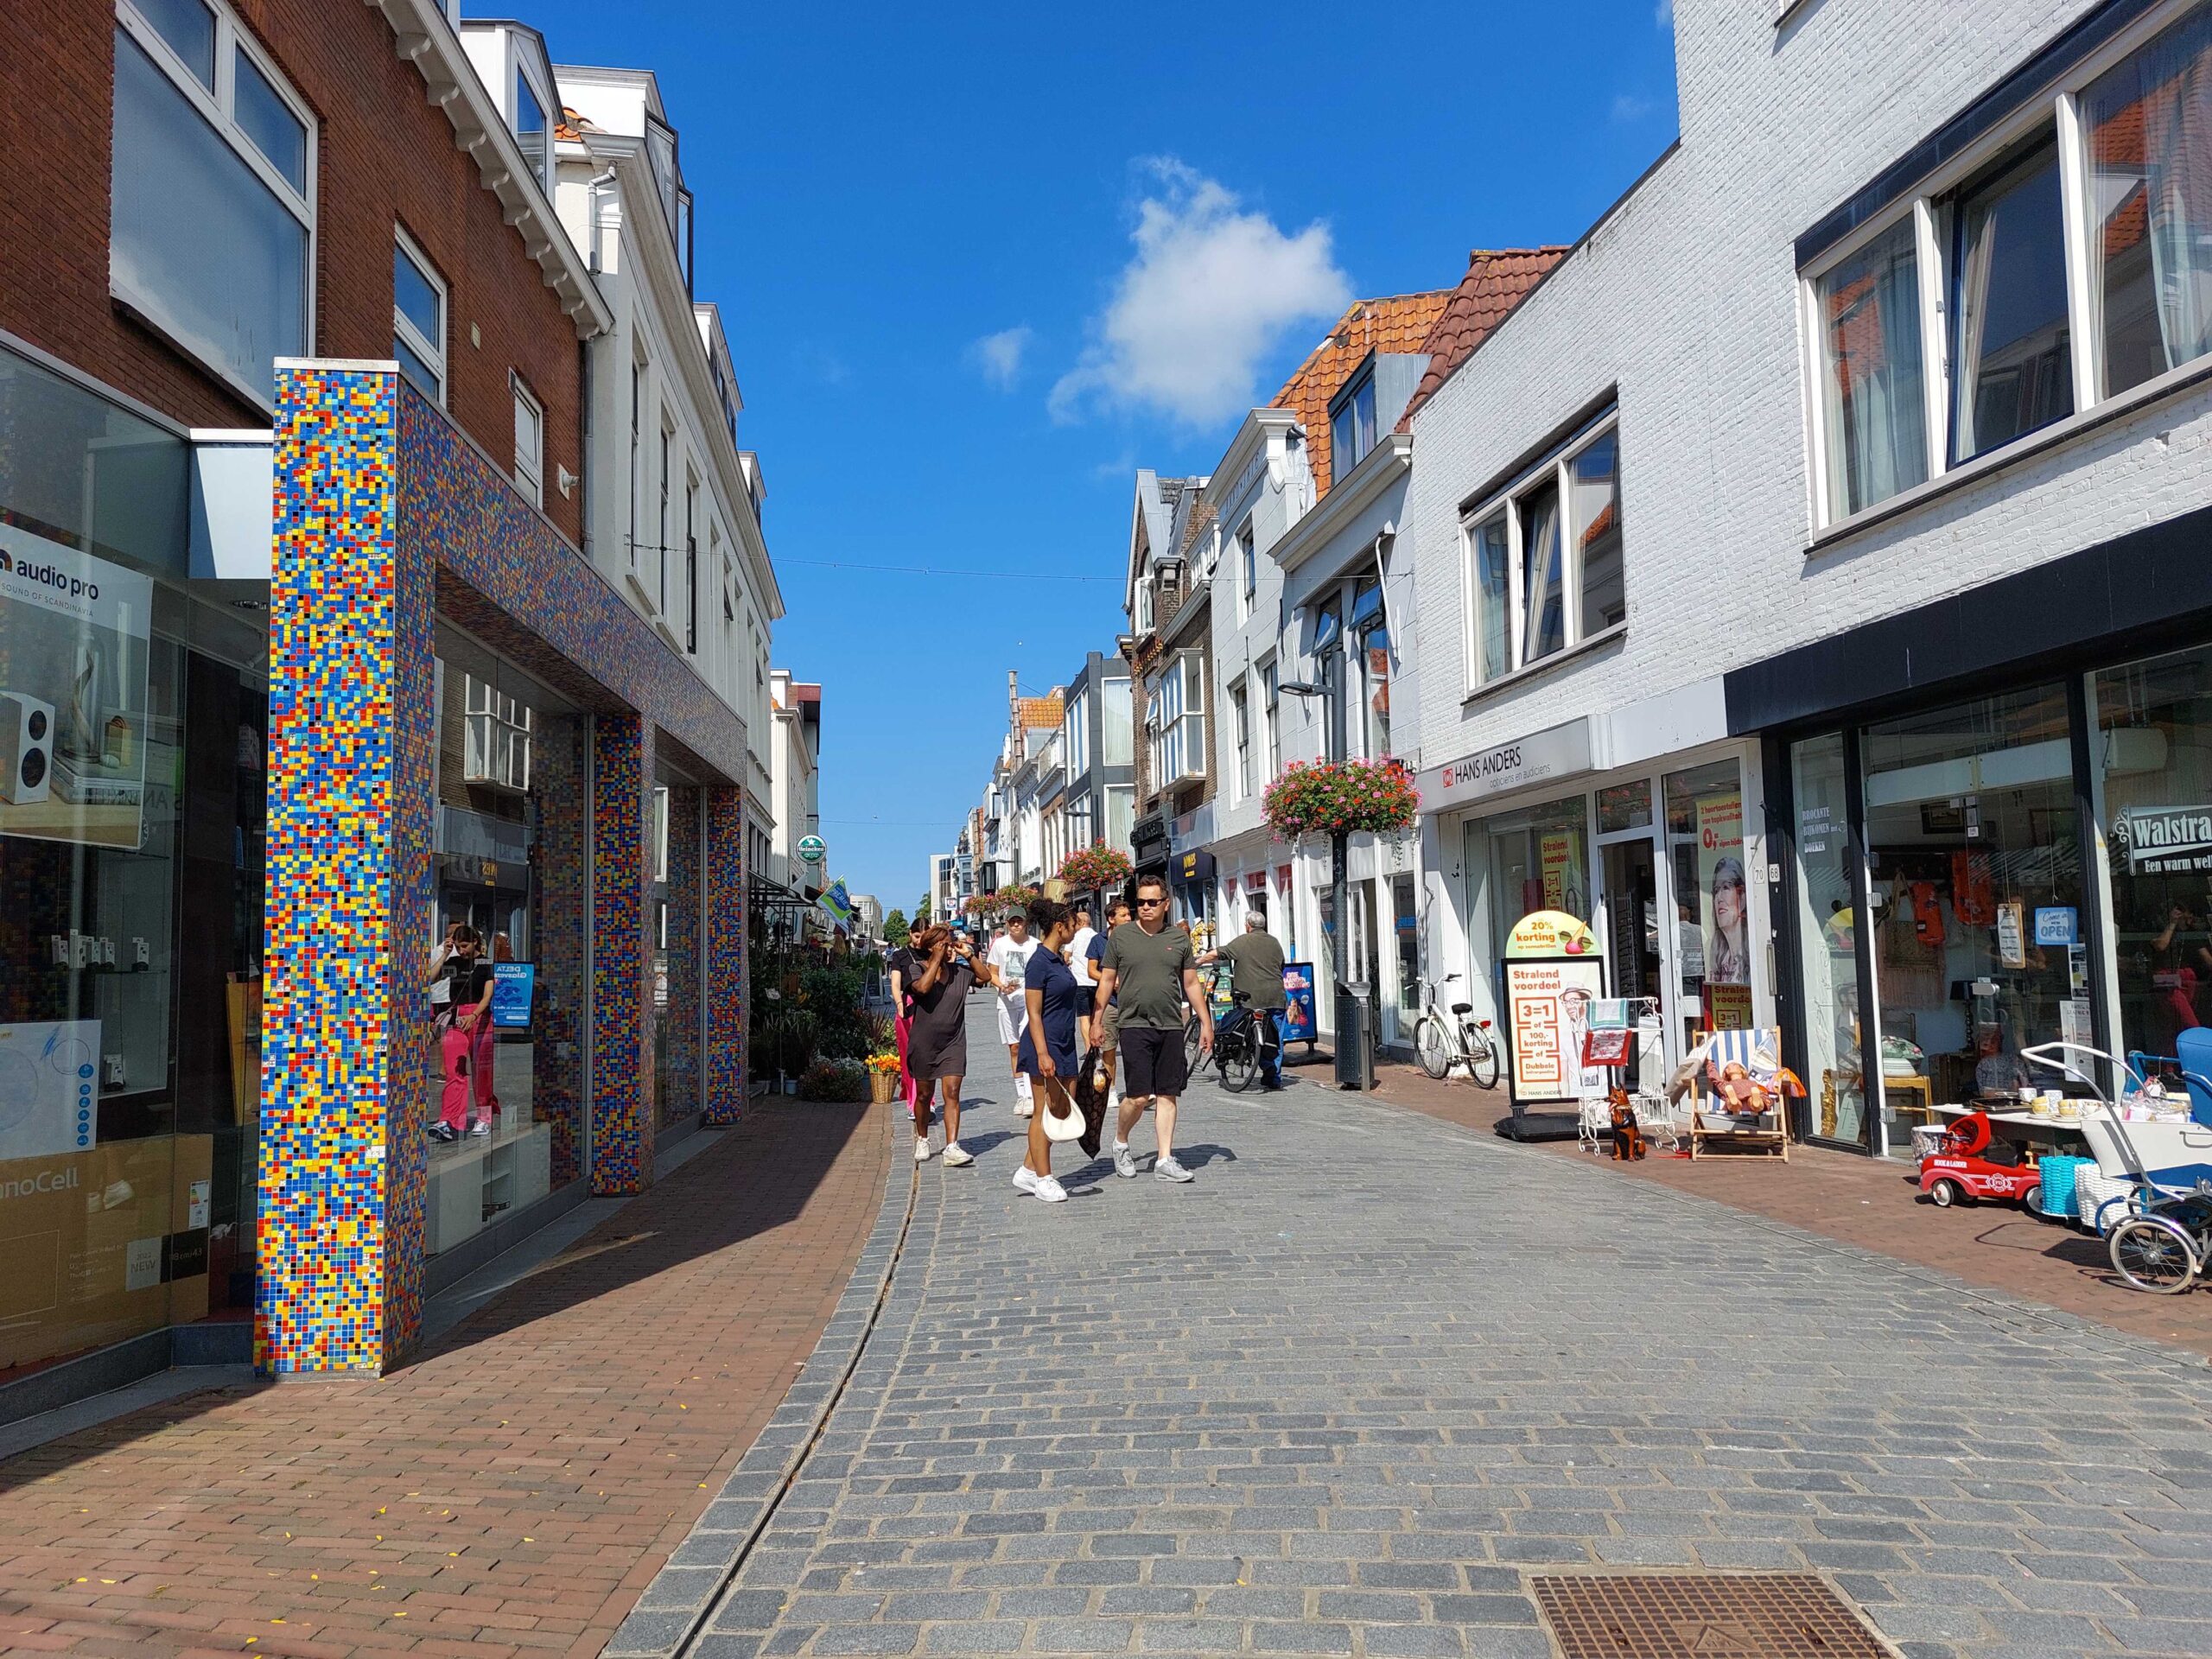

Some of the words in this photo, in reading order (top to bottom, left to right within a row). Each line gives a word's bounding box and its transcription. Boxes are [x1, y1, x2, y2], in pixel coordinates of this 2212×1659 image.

[17, 560, 67, 589] audio
[71, 578, 99, 601] pro
[1, 582, 29, 597] SOUND
[32, 592, 42, 601] OF
[45, 596, 94, 617] SCANDINAVIA
[1455, 760, 1480, 785] HANS
[1482, 747, 1521, 777] ANDERS
[1489, 774, 1515, 789] opticiens
[1516, 772, 1522, 781] en
[1523, 763, 1551, 779] audiciens
[1802, 807, 1830, 821] BROCANTE
[2133, 814, 2212, 848] Walstra
[1542, 838, 1568, 852] Stralend
[1804, 841, 1825, 853] BOEKEN
[2144, 861, 2162, 873] Een
[2164, 859, 2191, 872] warm
[1755, 869, 1764, 880] 70
[1770, 868, 1778, 878] 68
[2043, 912, 2060, 922] Come
[1531, 921, 1554, 930] 20%
[2041, 925, 2070, 937] OPEN
[1516, 933, 1555, 943] korting
[1513, 969, 1559, 979] Stralend
[1514, 981, 1560, 990] voordeel
[1523, 1005, 1549, 1017] 3=1
[130, 1259, 156, 1274] NEW
